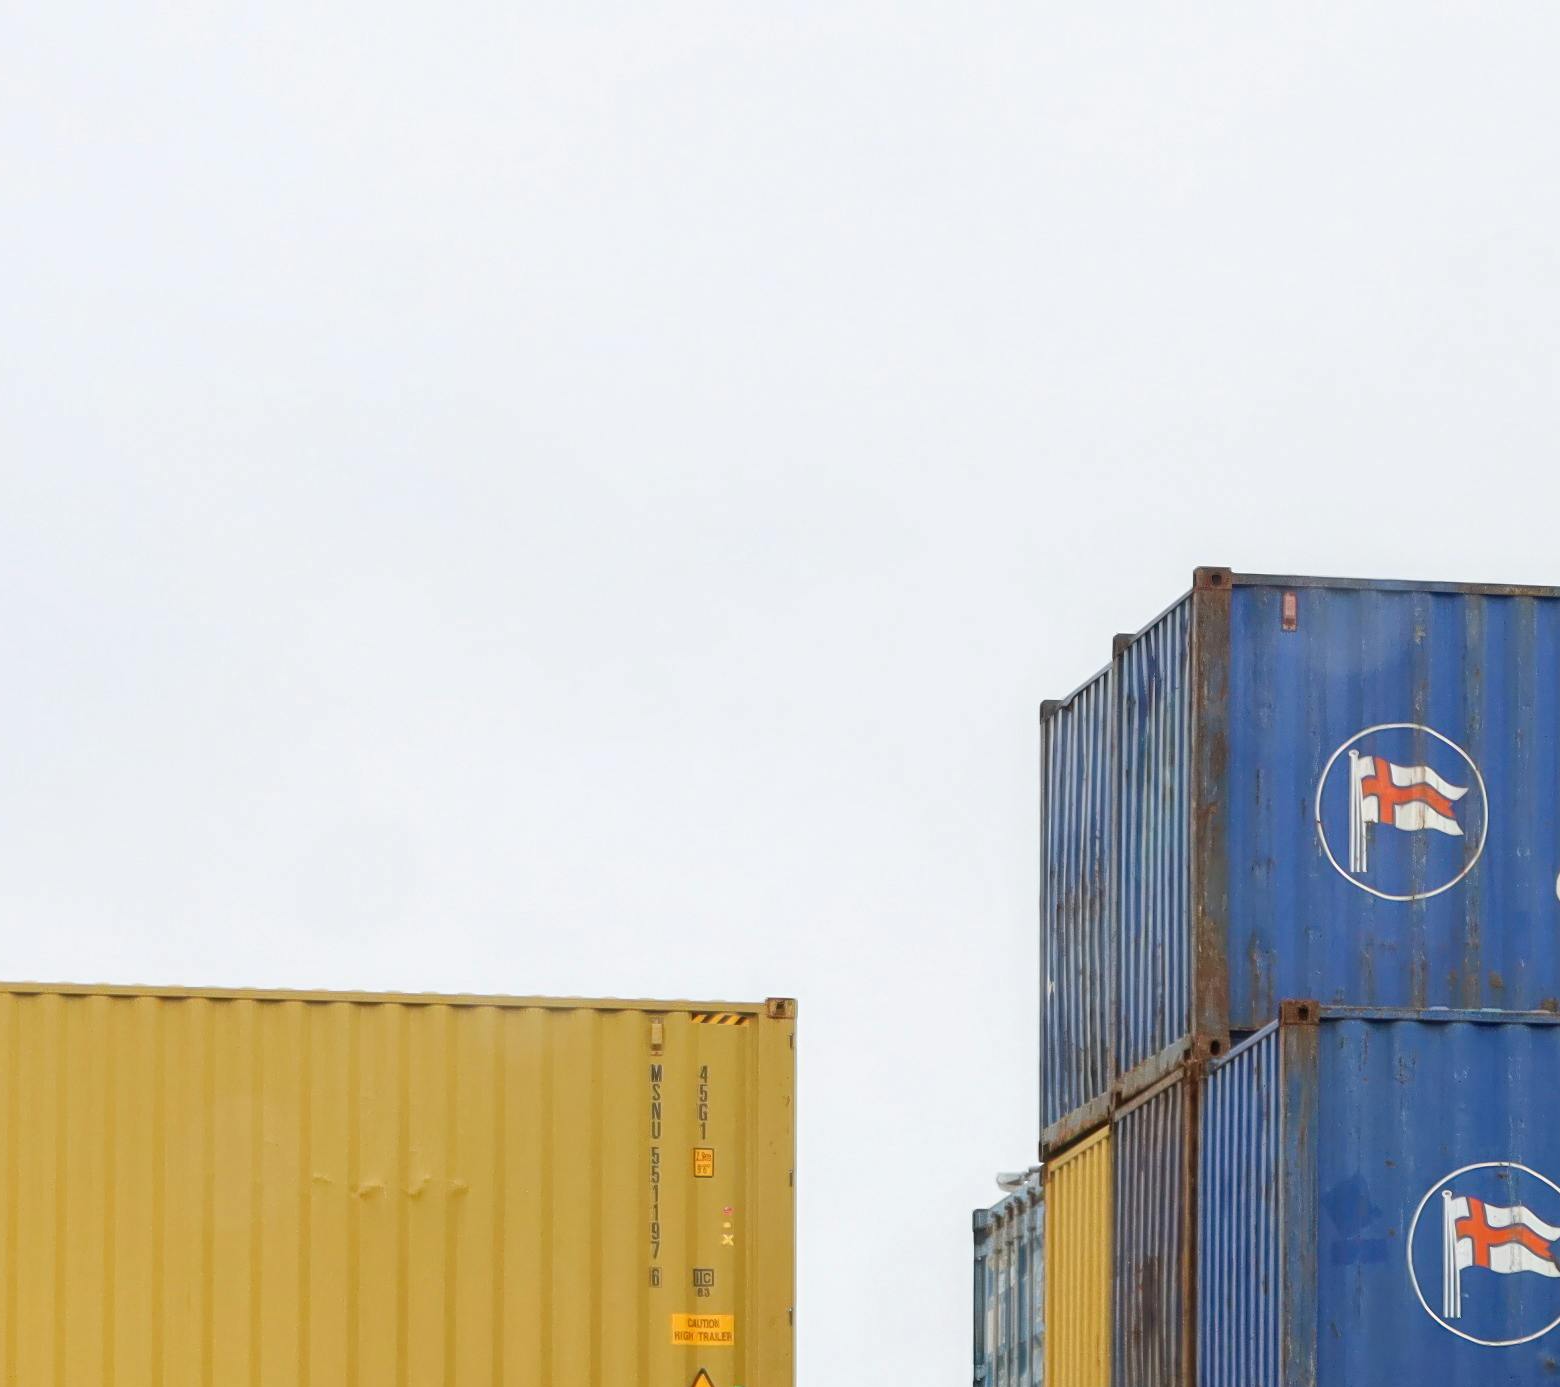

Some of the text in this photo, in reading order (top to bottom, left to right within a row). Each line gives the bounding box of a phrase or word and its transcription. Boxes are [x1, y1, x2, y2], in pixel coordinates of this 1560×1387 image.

[650, 1064, 663, 1140] MSNU
[698, 1065, 709, 1140] 45G1
[650, 1147, 660, 1260] 551197
[674, 1331, 732, 1342] HIGH TRAILER
[687, 1318, 719, 1329] CAUTION
